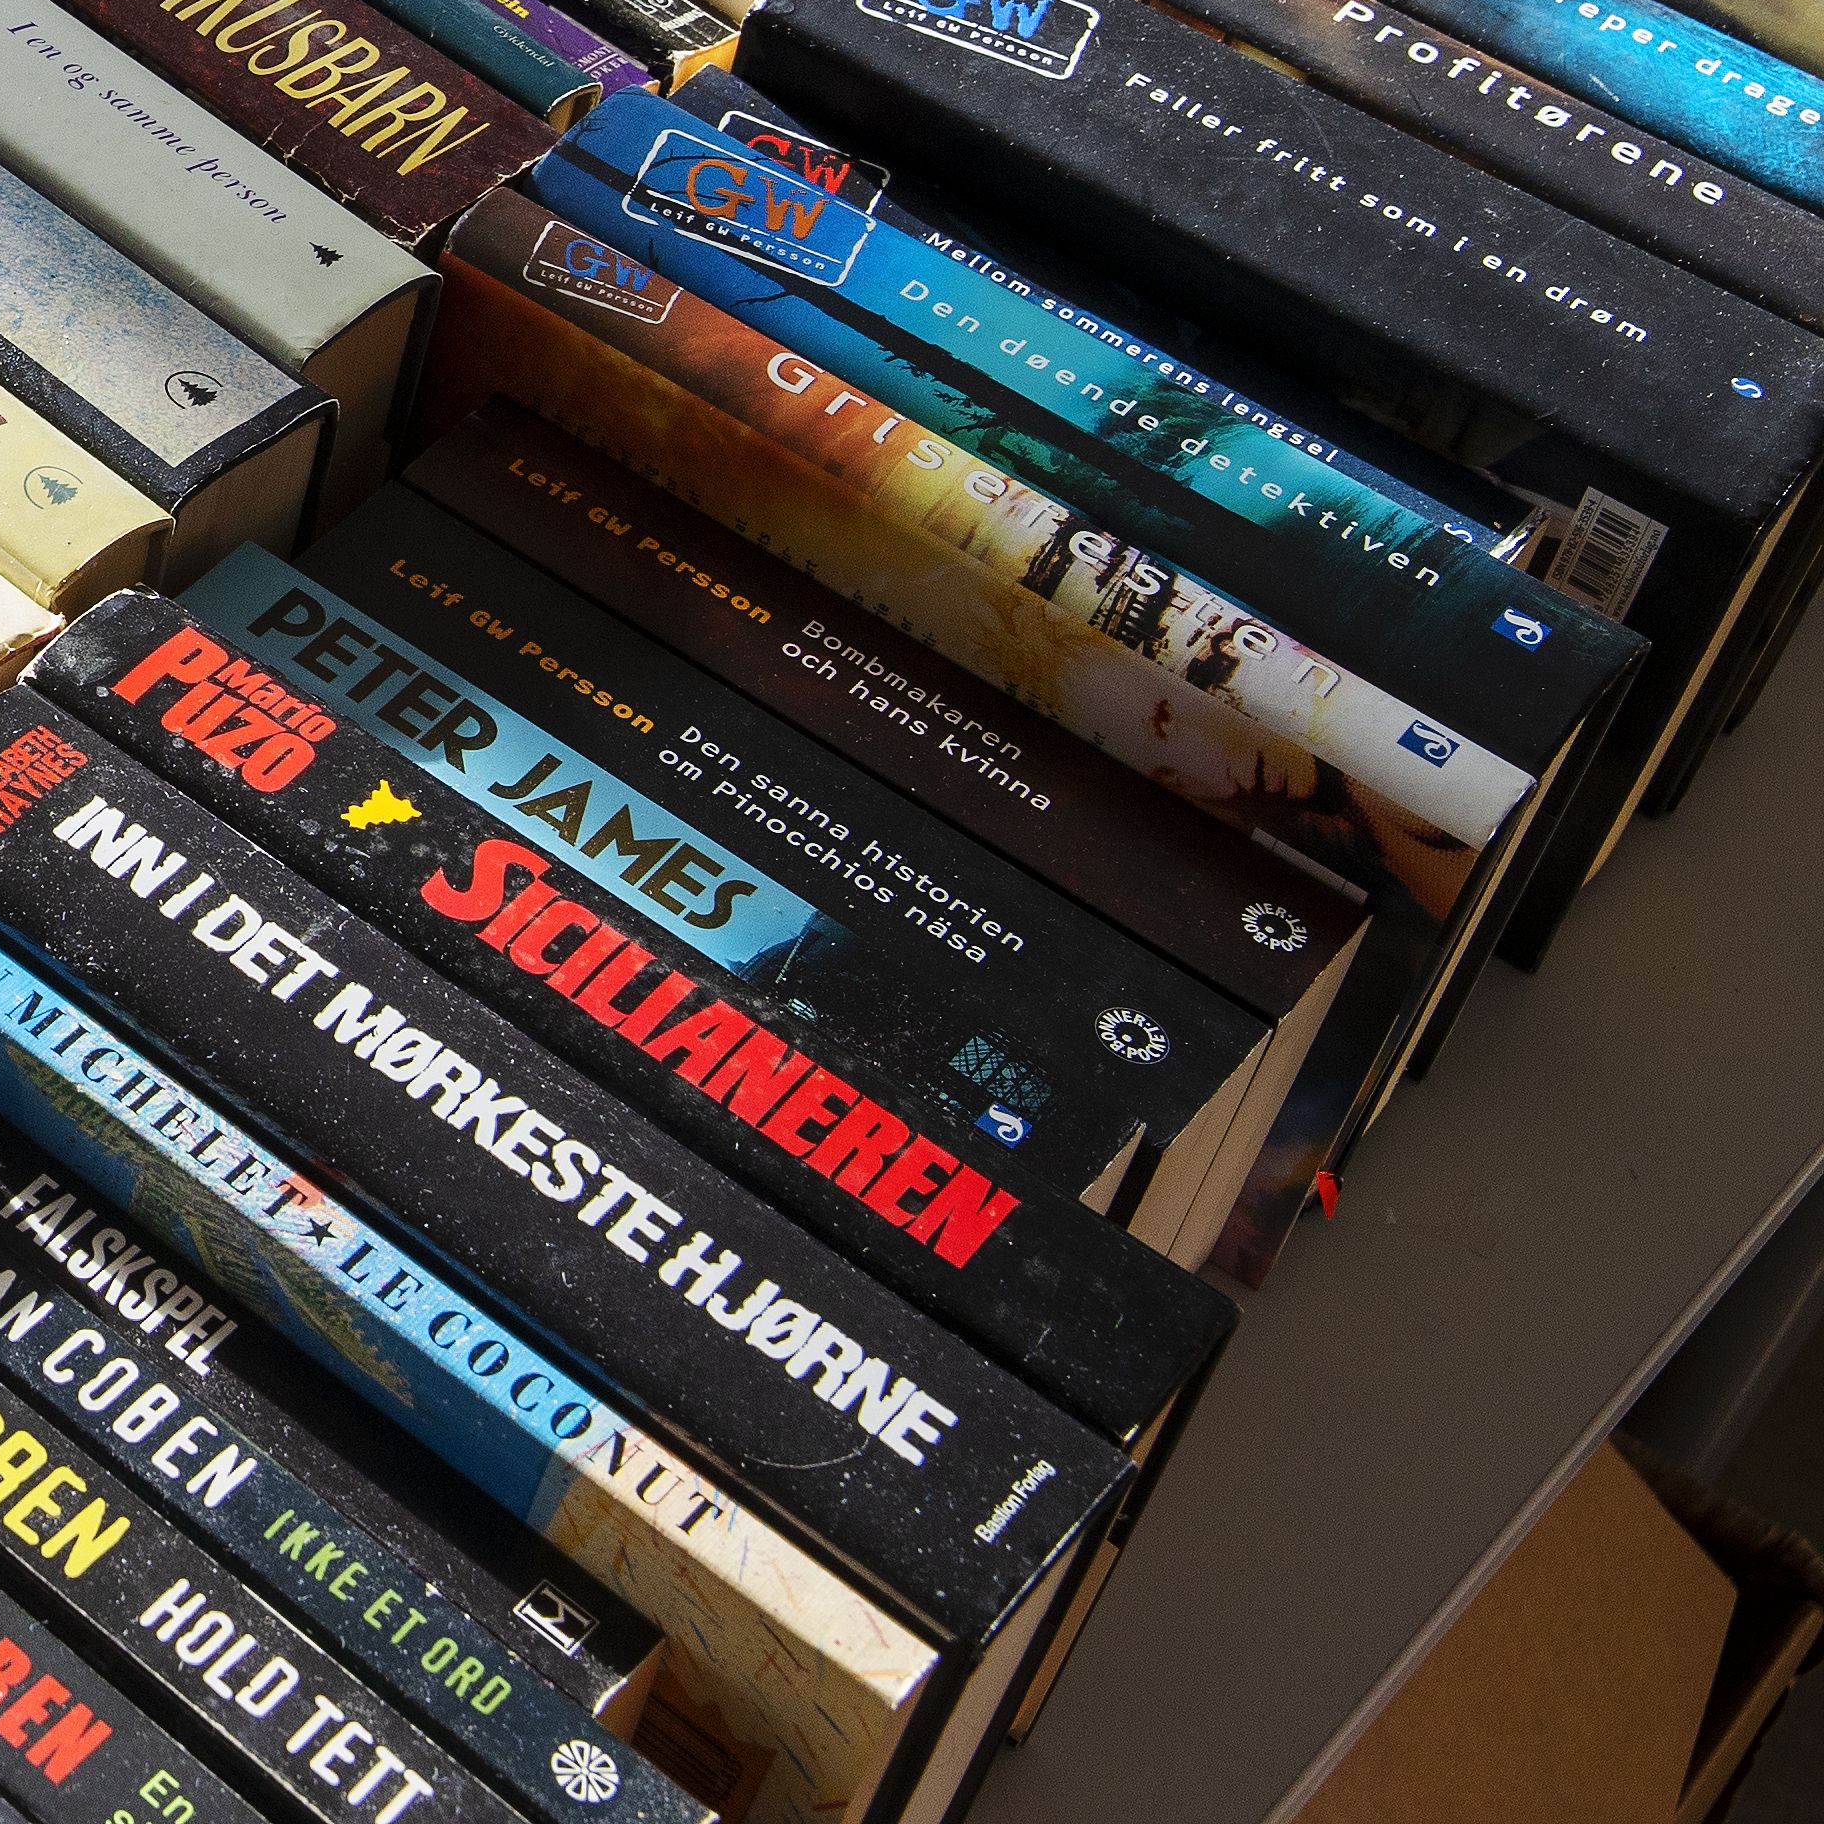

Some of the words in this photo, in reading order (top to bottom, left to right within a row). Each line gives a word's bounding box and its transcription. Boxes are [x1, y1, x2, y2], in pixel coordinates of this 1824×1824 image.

[96, 79, 197, 159] samme
[185, 143, 291, 227] person
[1123, 70, 1244, 142] Faller
[1255, 136, 1349, 196] fritt
[1358, 188, 1440, 245] som
[1481, 246, 1531, 285] en
[1543, 283, 1651, 347] drøm
[764, 351, 1343, 700] Grisefesten
[898, 276, 984, 336] Den
[997, 330, 1162, 439] døende
[1179, 435, 1446, 591] detektiven
[245, 583, 499, 776] PETER
[489, 747, 760, 936] JAMES
[388, 557, 464, 606] Leif
[468, 604, 516, 643] GW
[517, 634, 657, 737] Persson
[655, 744, 713, 788] om
[713, 777, 899, 903] Pinocchios
[901, 890, 991, 967] näsa
[677, 723, 741, 777] Den
[749, 768, 854, 847] sanna
[859, 833, 1028, 955] historien
[53, 795, 186, 901] INN
[194, 894, 342, 1005] DET
[314, 980, 685, 1266] MØRKESTE
[660, 1232, 957, 1467] HJØRNE
[421, 835, 1023, 1270] SICILIANEREN
[0, 1172, 241, 1378] FALSKSPEL
[6, 992, 310, 1222] MICHELET
[336, 1238, 426, 1313] LE
[426, 1310, 722, 1538] COCONUT
[42, 1328, 259, 1510] COBEN
[263, 1510, 359, 1601] IKKE
[362, 1587, 428, 1646] ET
[421, 1637, 513, 1717] ORD
[972, 1490, 1030, 1546] Bastion
[1009, 1457, 1058, 1510] Forlag
